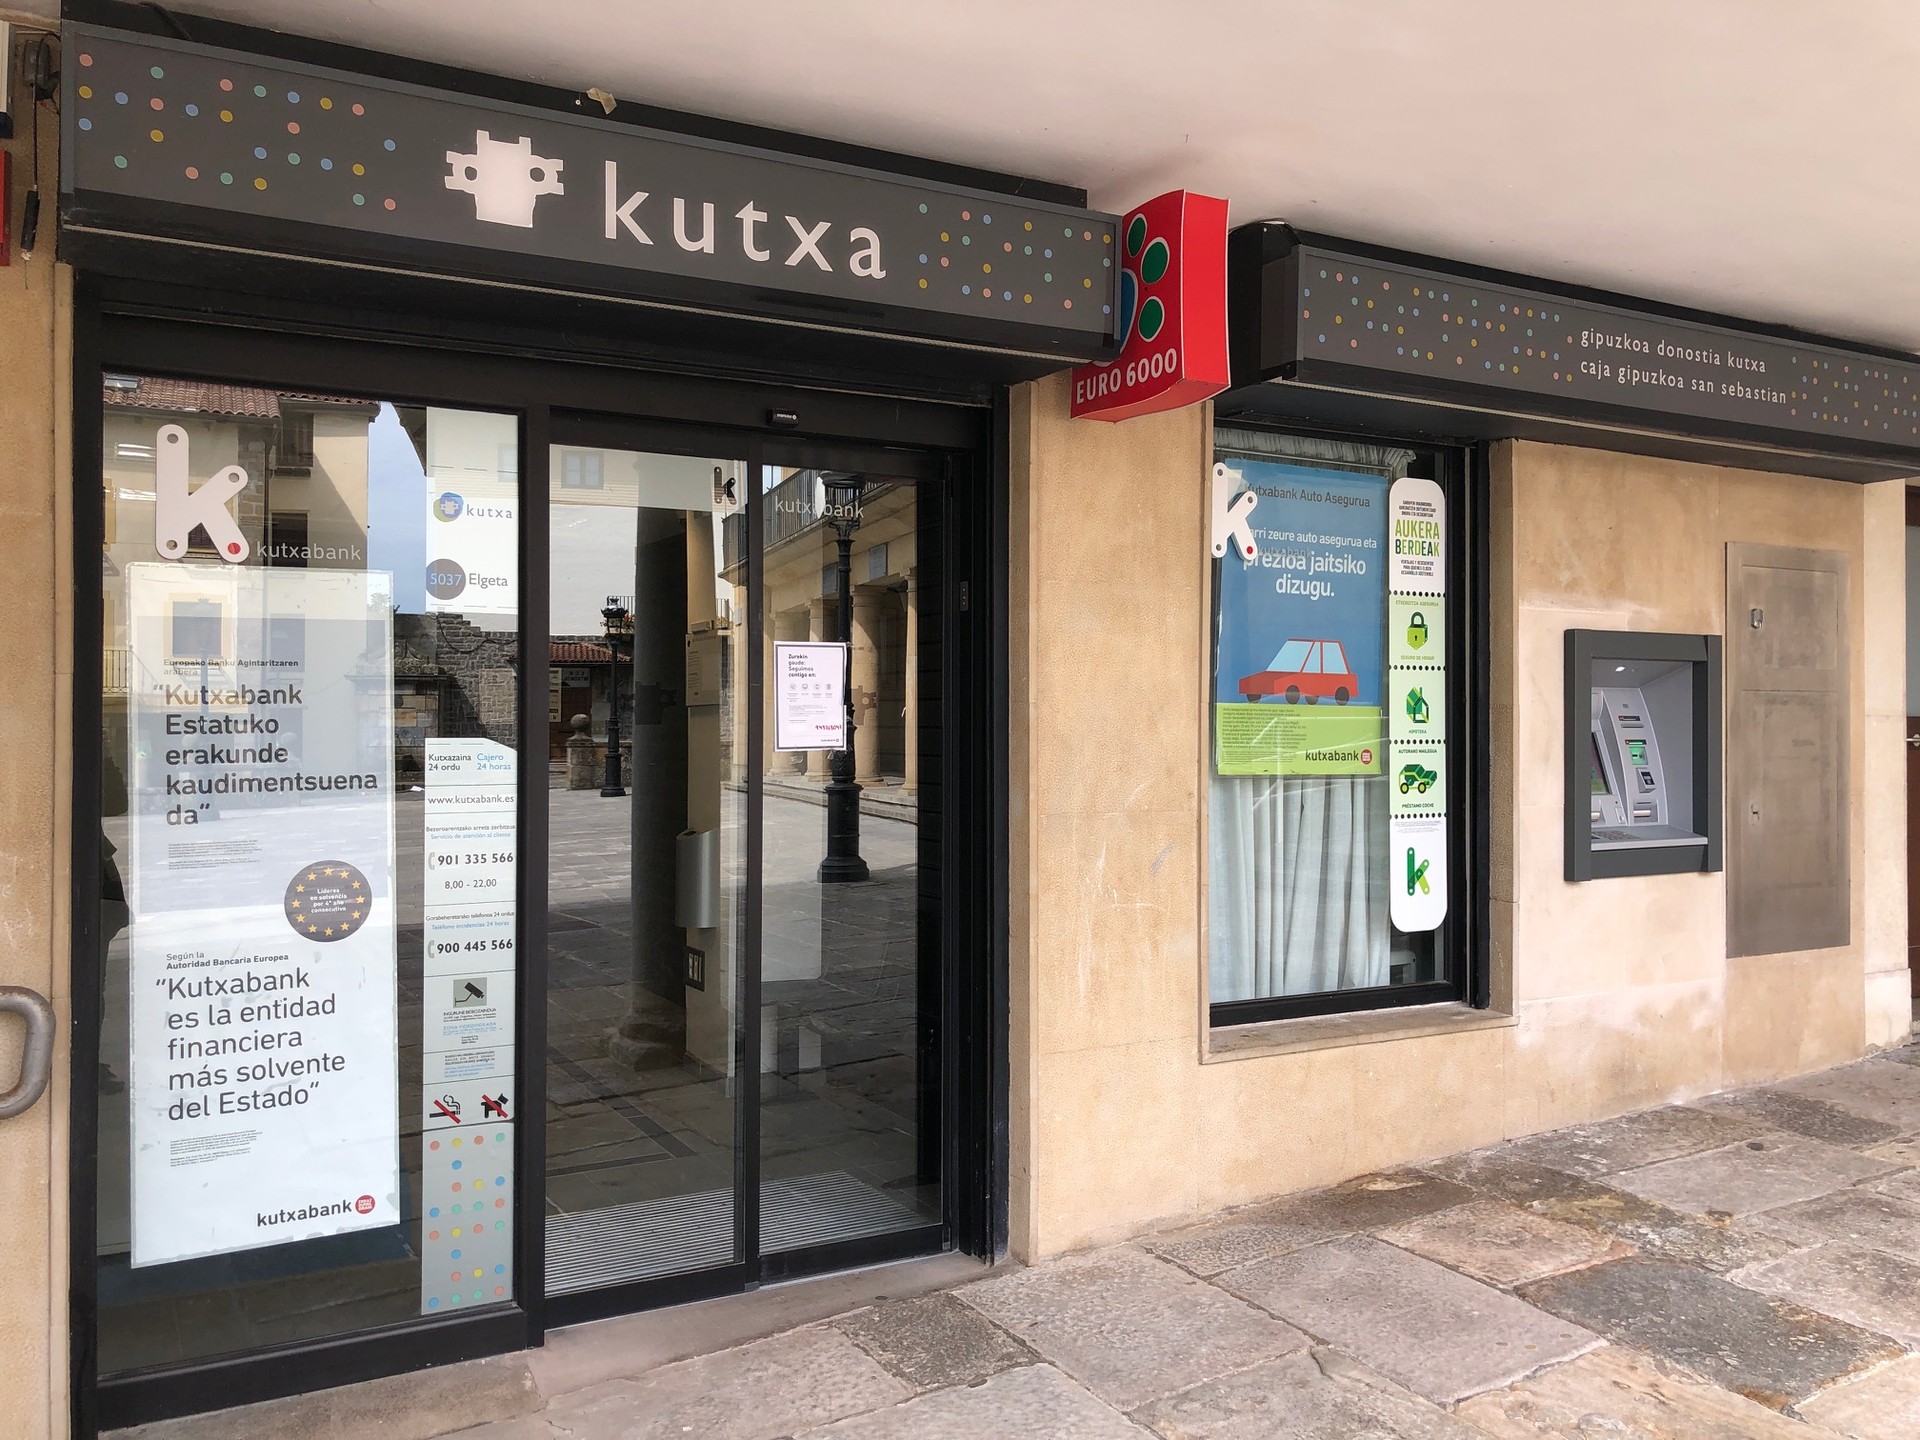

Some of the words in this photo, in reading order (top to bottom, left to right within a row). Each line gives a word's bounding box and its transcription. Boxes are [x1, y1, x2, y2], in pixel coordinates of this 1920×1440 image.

[605, 160, 886, 279] kutxa
[1581, 328, 1650, 355] gipuzkoa
[1657, 339, 1721, 365] donostia
[1727, 351, 1766, 373] kutxa
[1076, 368, 1121, 404] EURO
[1126, 348, 1177, 387] 6000
[1580, 360, 1611, 380] caja
[1617, 365, 1684, 389] gipuzkoa
[1691, 378, 1714, 393] san
[1721, 381, 1787, 404] sebastian
[775, 496, 864, 519] kutxbank
[1299, 490, 1323, 504] Auto
[1324, 492, 1371, 508] Asegurua
[466, 504, 512, 519] kutxa
[1267, 529, 1295, 541] zeure
[1296, 533, 1318, 544] auto
[1319, 535, 1362, 549] asegurua
[1363, 538, 1377, 549] eta
[1395, 518, 1440, 540] AUKERA
[258, 541, 361, 561] kutxabank
[1395, 538, 1440, 557] BERDEAK
[1308, 550, 1366, 575] jaitsiko
[430, 574, 462, 585] 5037
[468, 573, 508, 588] Elgeta
[1275, 573, 1335, 600] dizugu.
[163, 659, 206, 668] Europako
[237, 659, 299, 669] Agintaritzaren
[166, 713, 280, 735] Estatuko
[165, 742, 289, 765] erakunde
[428, 754, 471, 762] Kutxazaina
[476, 752, 504, 762] Cajero
[1305, 749, 1360, 762] kutxabank
[428, 763, 438, 771] 24
[441, 763, 461, 771] ordu
[476, 762, 487, 770] 24
[489, 762, 511, 770] horas
[166, 772, 378, 795] kaudimentsuena
[427, 795, 515, 804] www.kutxabank.es
[437, 854, 459, 866] 901
[464, 853, 487, 865] 335
[491, 852, 514, 864] 566
[166, 953, 195, 962] Según
[197, 951, 205, 959] la
[437, 943, 460, 954] 900
[464, 941, 486, 952] 445
[491, 939, 513, 951] 566
[166, 959, 211, 970] Autoridad
[213, 957, 251, 967] Bancaria
[253, 954, 290, 964] Europea
[168, 1011, 200, 1030] es
[208, 1003, 232, 1026] la
[240, 992, 336, 1023] entidad
[167, 1028, 303, 1060] financiera
[169, 1063, 228, 1090] más
[236, 1052, 346, 1083] solvente
[168, 1094, 210, 1121] del
[257, 1199, 352, 1227] kutxabank
